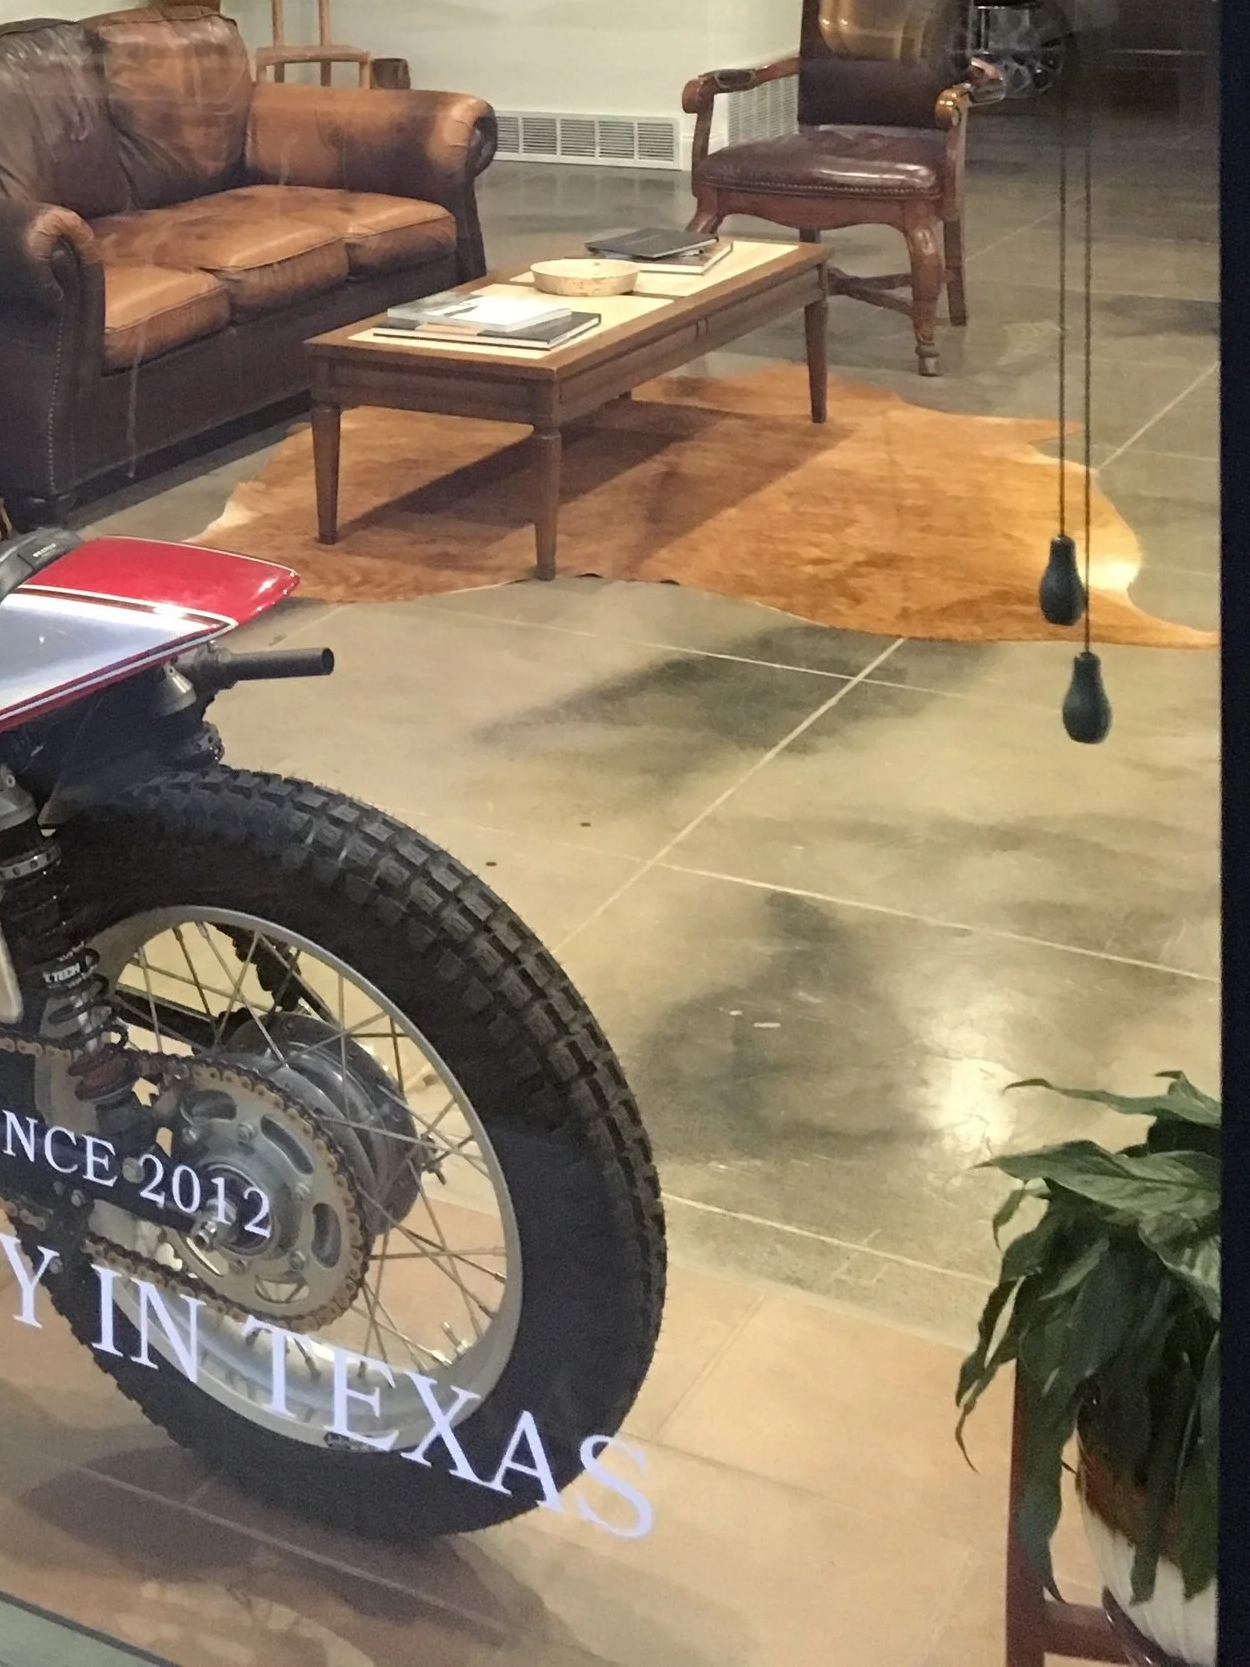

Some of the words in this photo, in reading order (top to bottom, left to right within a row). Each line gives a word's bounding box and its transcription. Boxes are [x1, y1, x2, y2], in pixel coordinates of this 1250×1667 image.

[139, 1154, 271, 1238] 2012
[91, 1263, 205, 1383] IN
[240, 1313, 654, 1540] TEXAS
